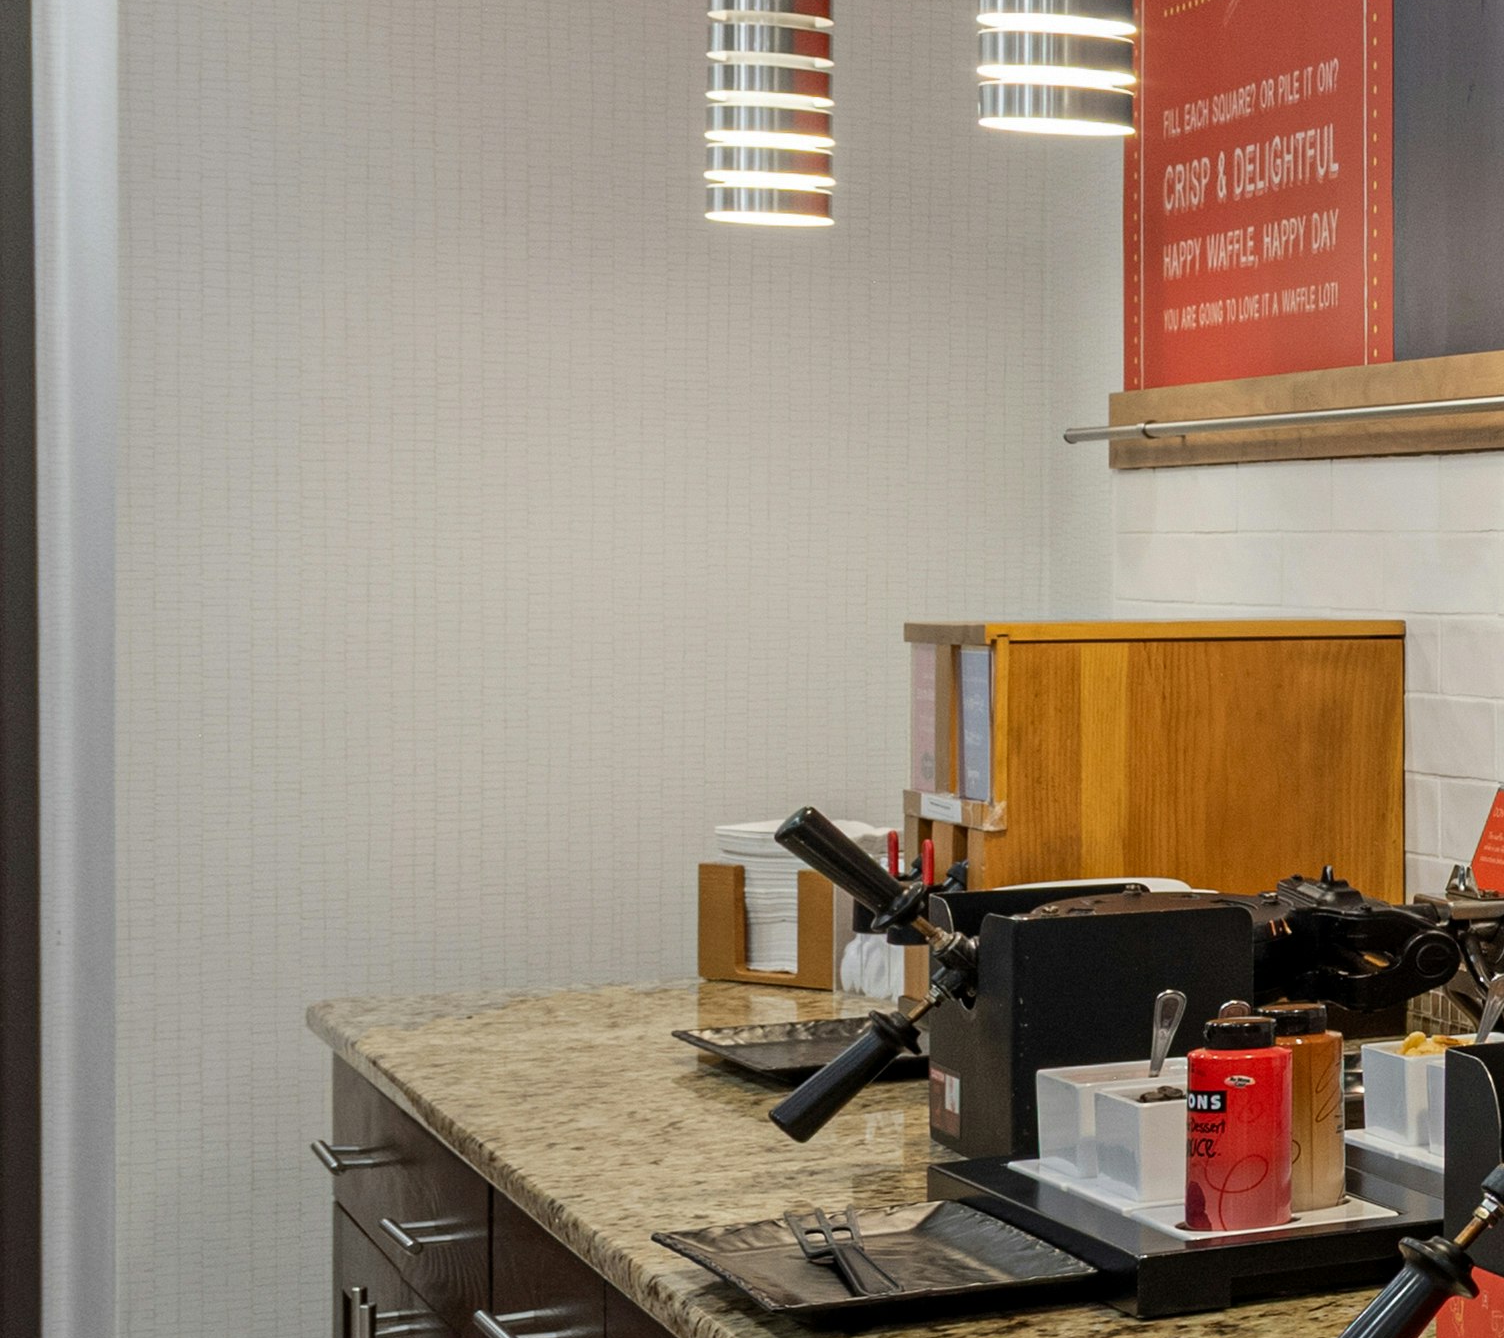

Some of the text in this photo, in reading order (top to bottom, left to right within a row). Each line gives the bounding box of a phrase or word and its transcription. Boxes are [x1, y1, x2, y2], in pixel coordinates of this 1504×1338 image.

[1163, 58, 1339, 137] FILL EACH SQUARE? OR PILE IT ON?
[1164, 123, 1339, 212] CRISP & DELIGHTFUL
[1163, 208, 1339, 278] HAPPY WAFFLE, HAPPY DAY
[1163, 281, 1339, 333] YOU ARE GOING TO LOVE IT A WAFFLE LOT!
[1187, 1093, 1222, 1110] ONS
